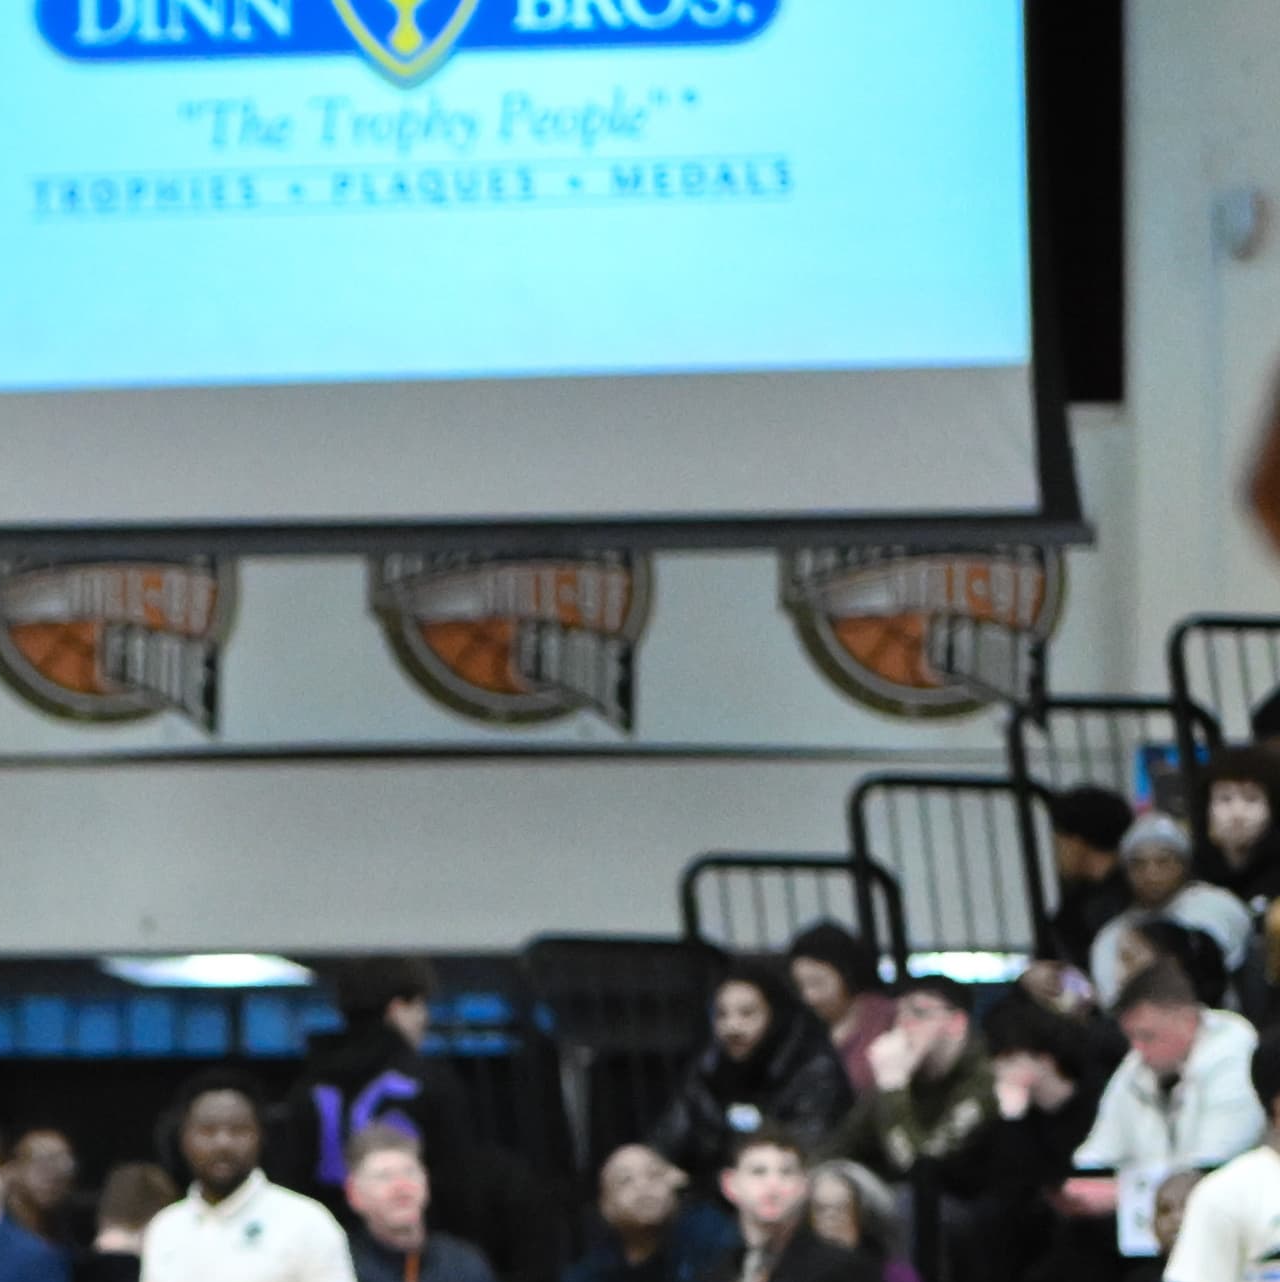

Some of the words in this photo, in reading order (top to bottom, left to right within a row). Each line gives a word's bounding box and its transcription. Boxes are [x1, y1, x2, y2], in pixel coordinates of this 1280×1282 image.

[74, 0, 293, 44] DINN
[513, 0, 754, 31] BROS.
[309, 93, 479, 156] Trophy
[32, 174, 260, 210] TROPHIES
[332, 167, 535, 206] PLAQUES
[609, 158, 793, 199] MEDALS
